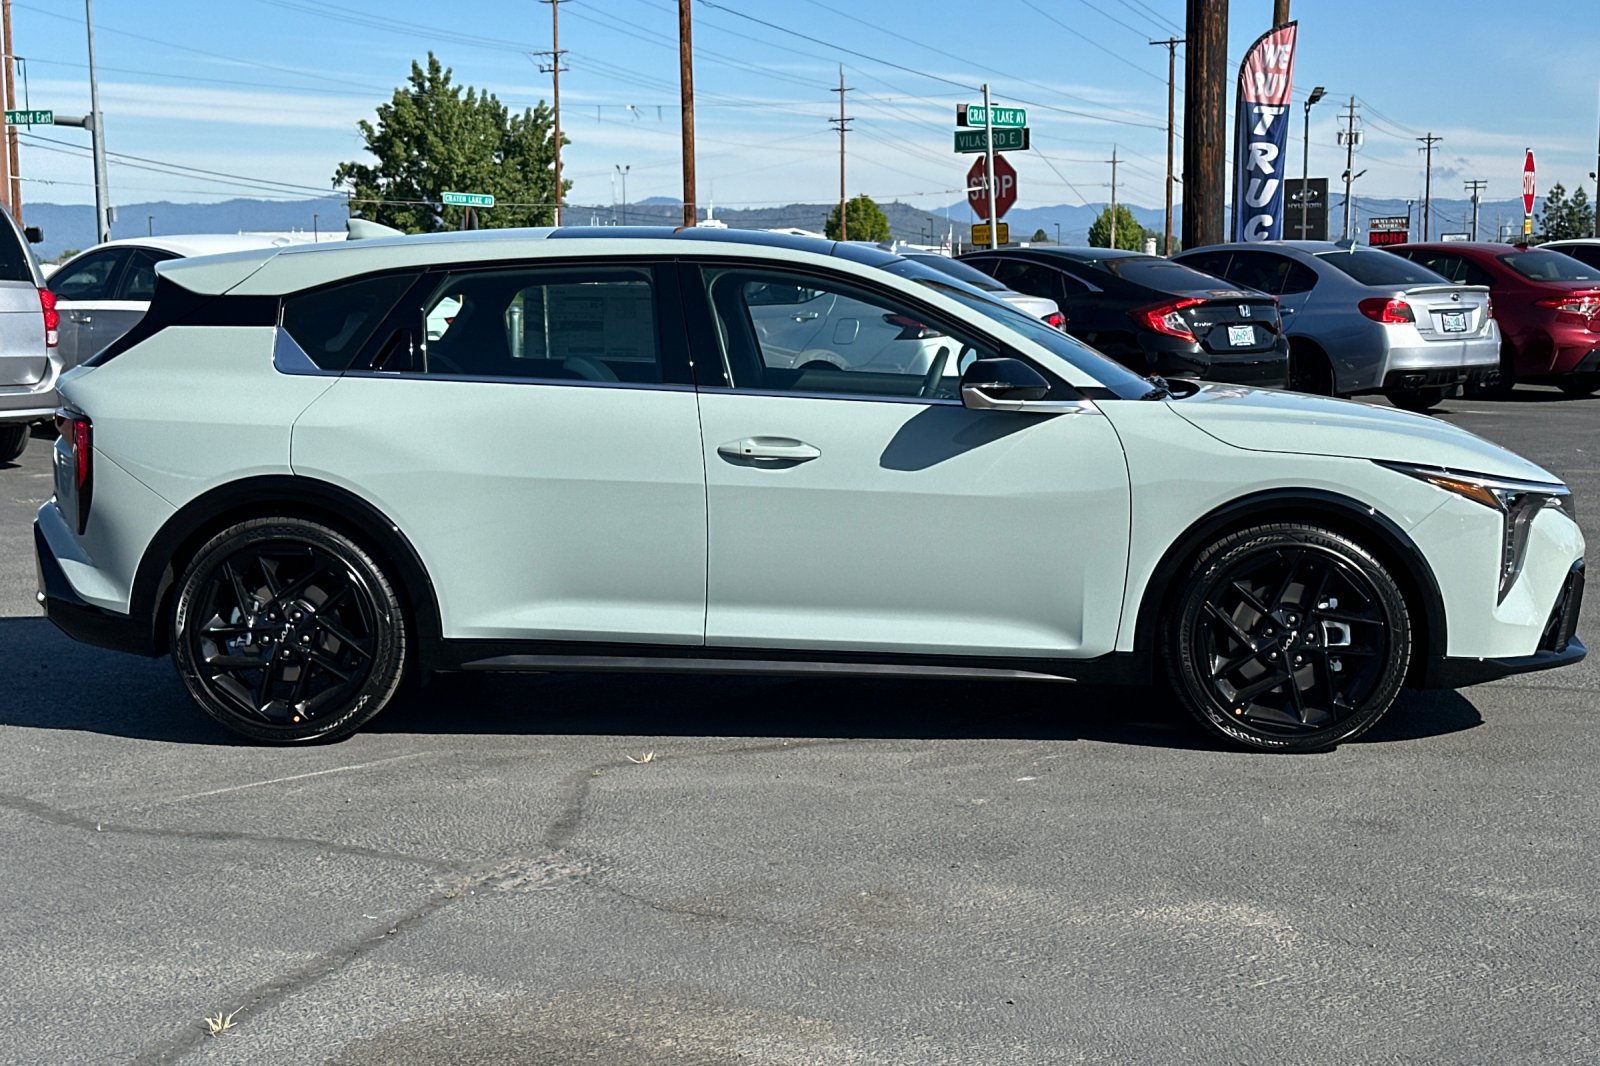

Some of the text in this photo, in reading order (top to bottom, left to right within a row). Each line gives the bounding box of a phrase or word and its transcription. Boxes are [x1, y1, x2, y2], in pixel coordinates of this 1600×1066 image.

[1262, 43, 1291, 69] WE
[1252, 71, 1287, 98] BUY
[15, 112, 33, 124] Road
[36, 112, 51, 124] East
[969, 108, 1025, 124] CRATR LAKE AV
[992, 133, 1006, 146] RD
[1523, 171, 1535, 195] STOP
